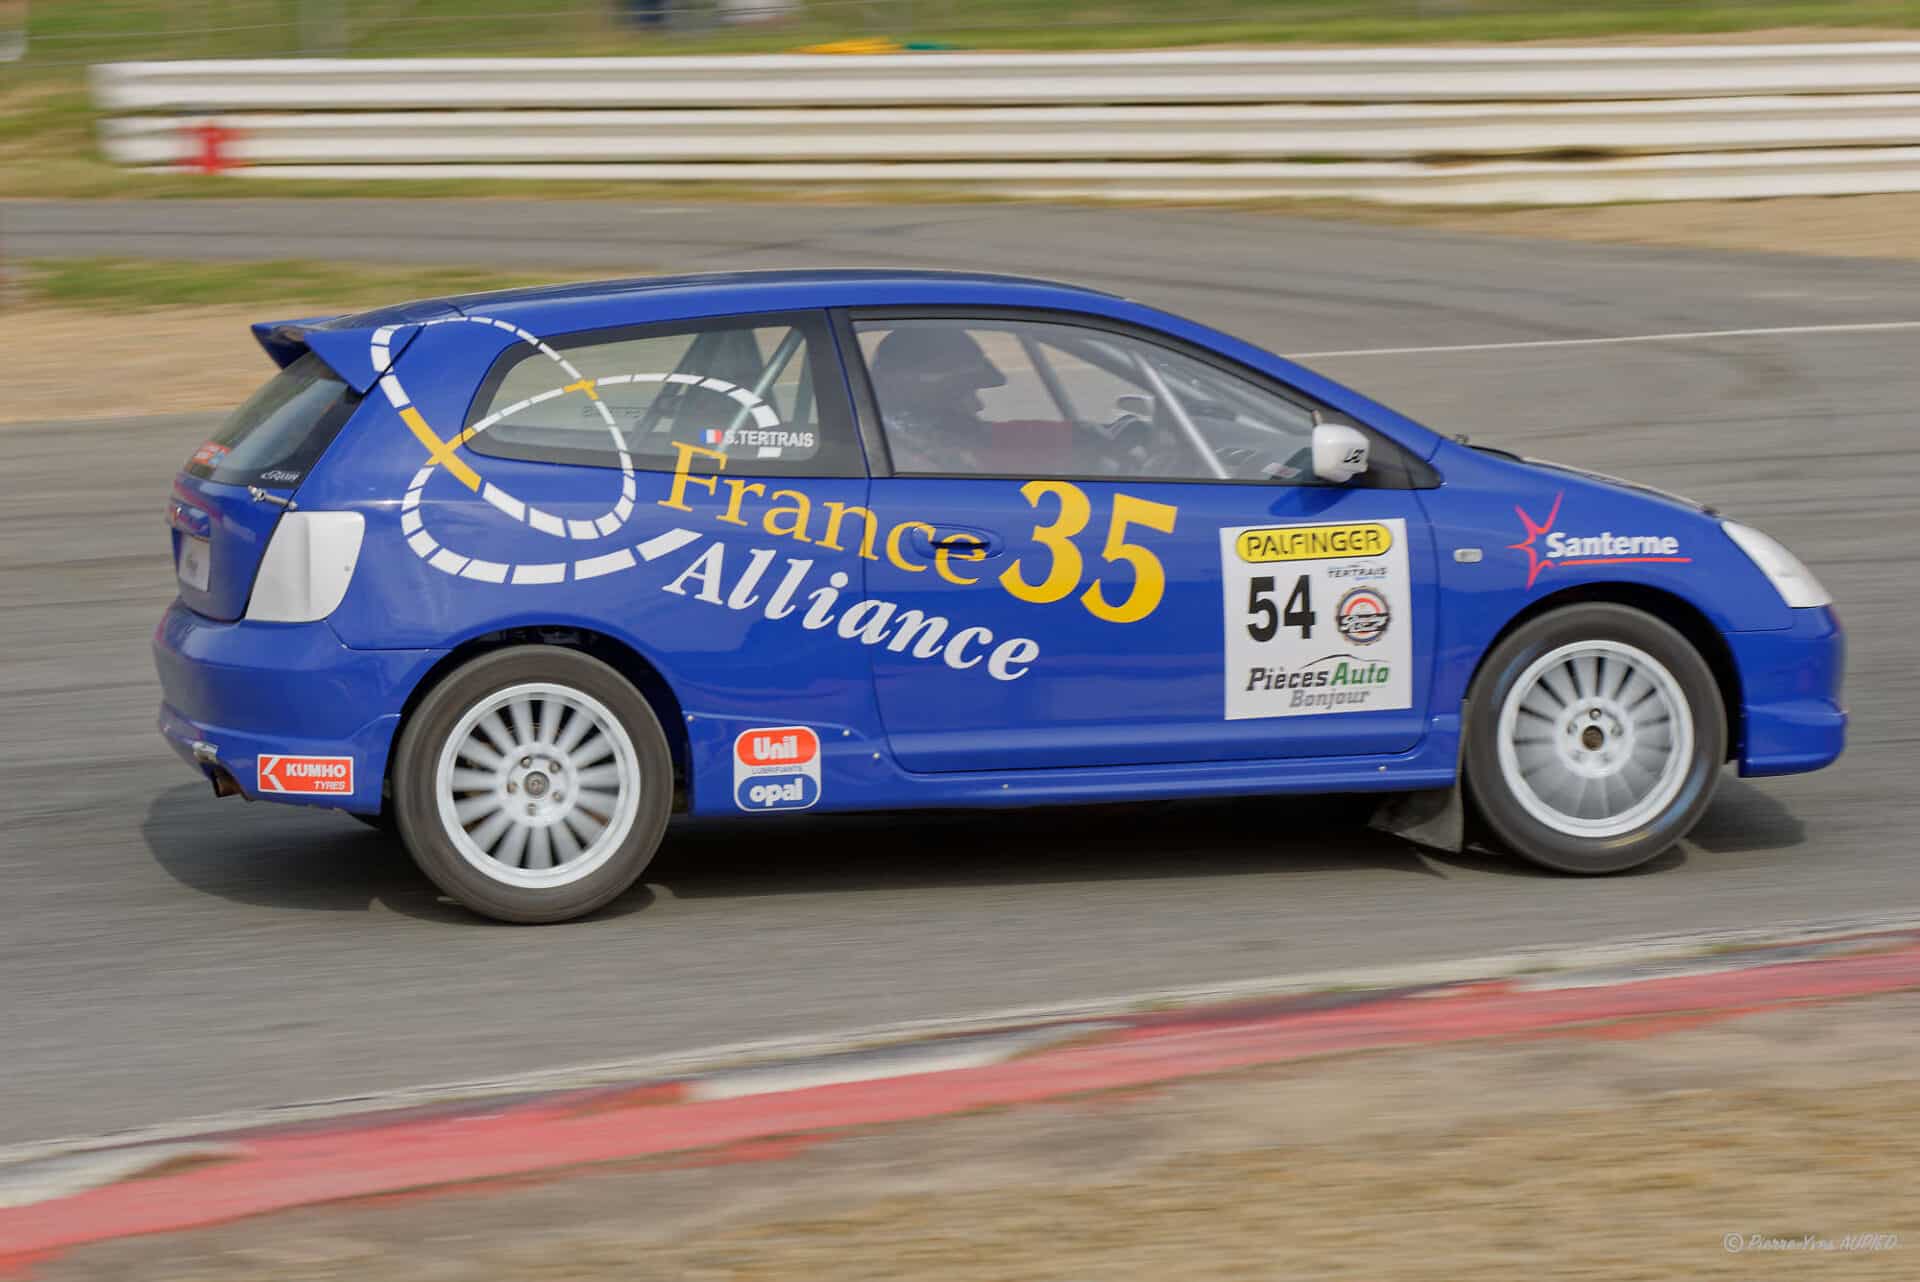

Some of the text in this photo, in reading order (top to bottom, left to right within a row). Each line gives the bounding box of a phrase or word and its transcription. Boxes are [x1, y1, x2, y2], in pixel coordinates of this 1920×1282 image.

[725, 429, 815, 448] S.TERTRAIS
[657, 440, 1178, 623] France 35
[1247, 530, 1382, 556] PALFINGER
[1546, 531, 1680, 558] Santerne
[662, 540, 1040, 681] Alliance
[1247, 574, 1316, 642] 54
[1289, 690, 1370, 709] Bonjour
[753, 735, 799, 760] Unil
[286, 763, 346, 778] KUMHO
[313, 780, 346, 791] TYRES
[750, 778, 804, 807] opal
